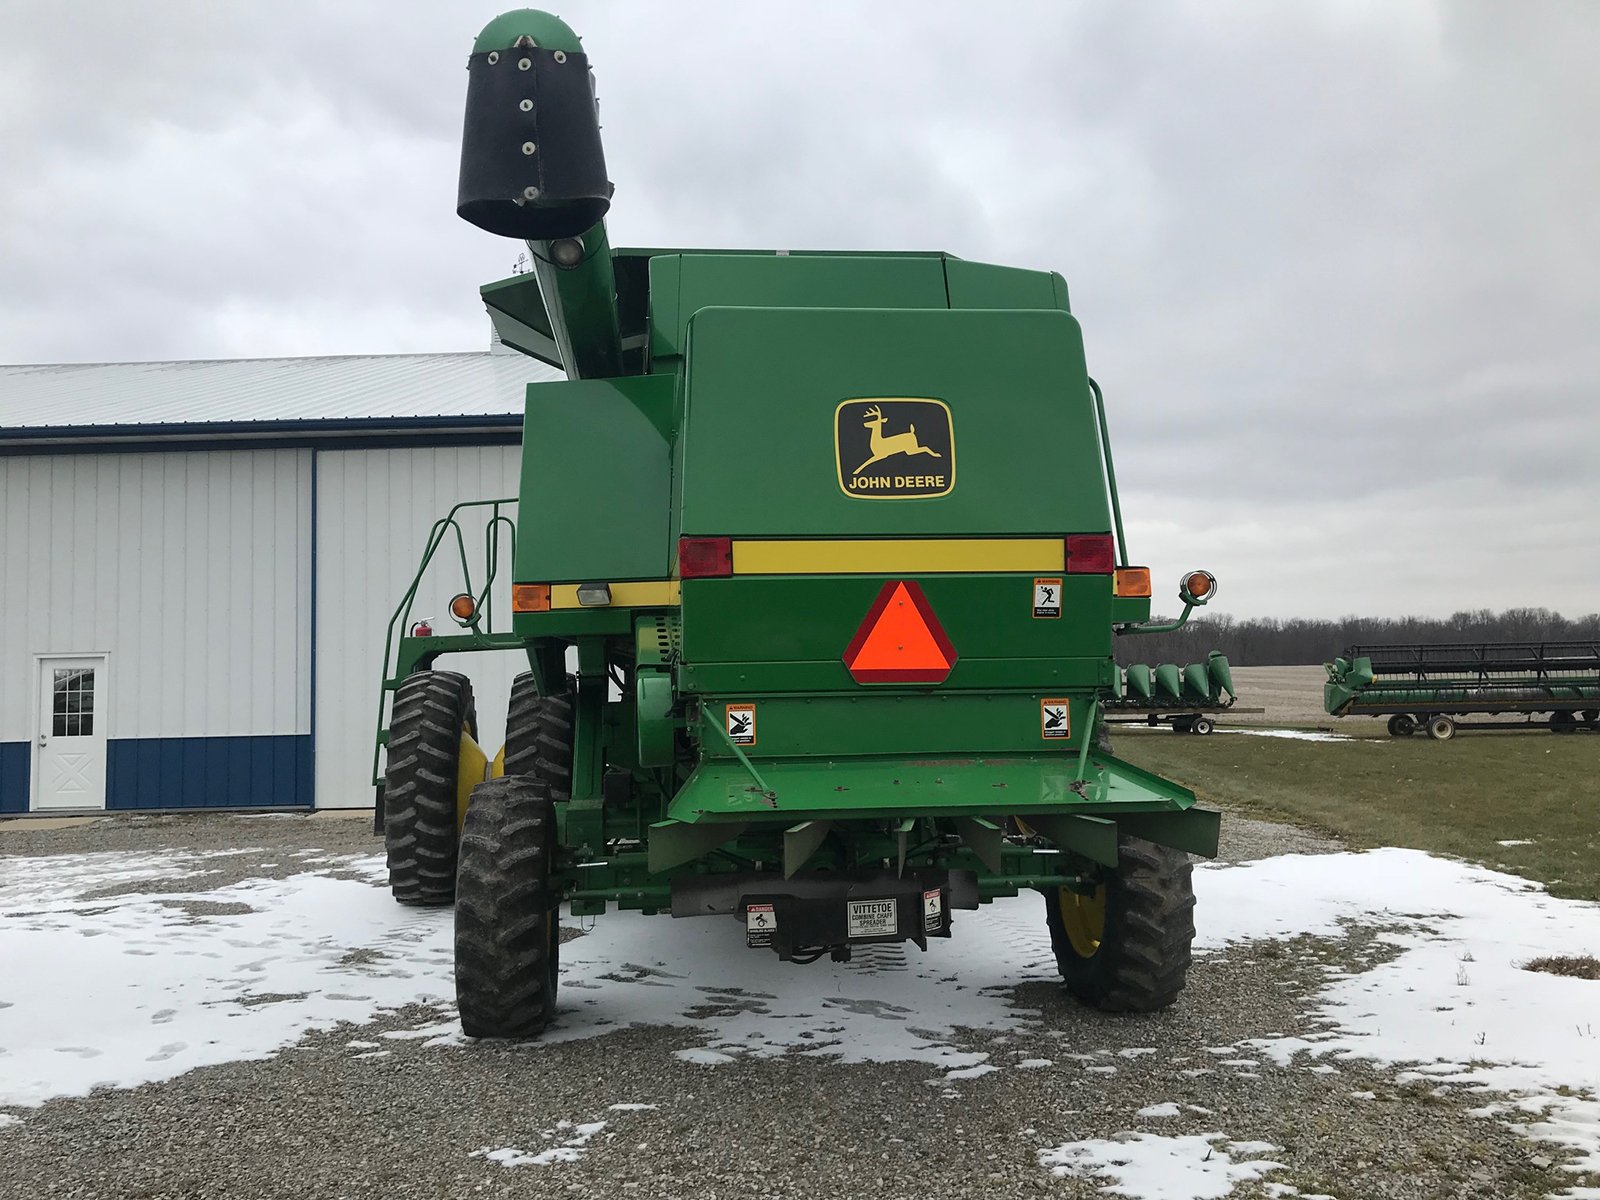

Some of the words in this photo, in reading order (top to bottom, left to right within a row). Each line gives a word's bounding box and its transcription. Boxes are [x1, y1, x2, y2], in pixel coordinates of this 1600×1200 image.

[849, 476, 891, 489] JOHN
[895, 475, 945, 488] DEERE
[853, 903, 892, 914] VITTETOE
[859, 919, 886, 927] SPREADER
